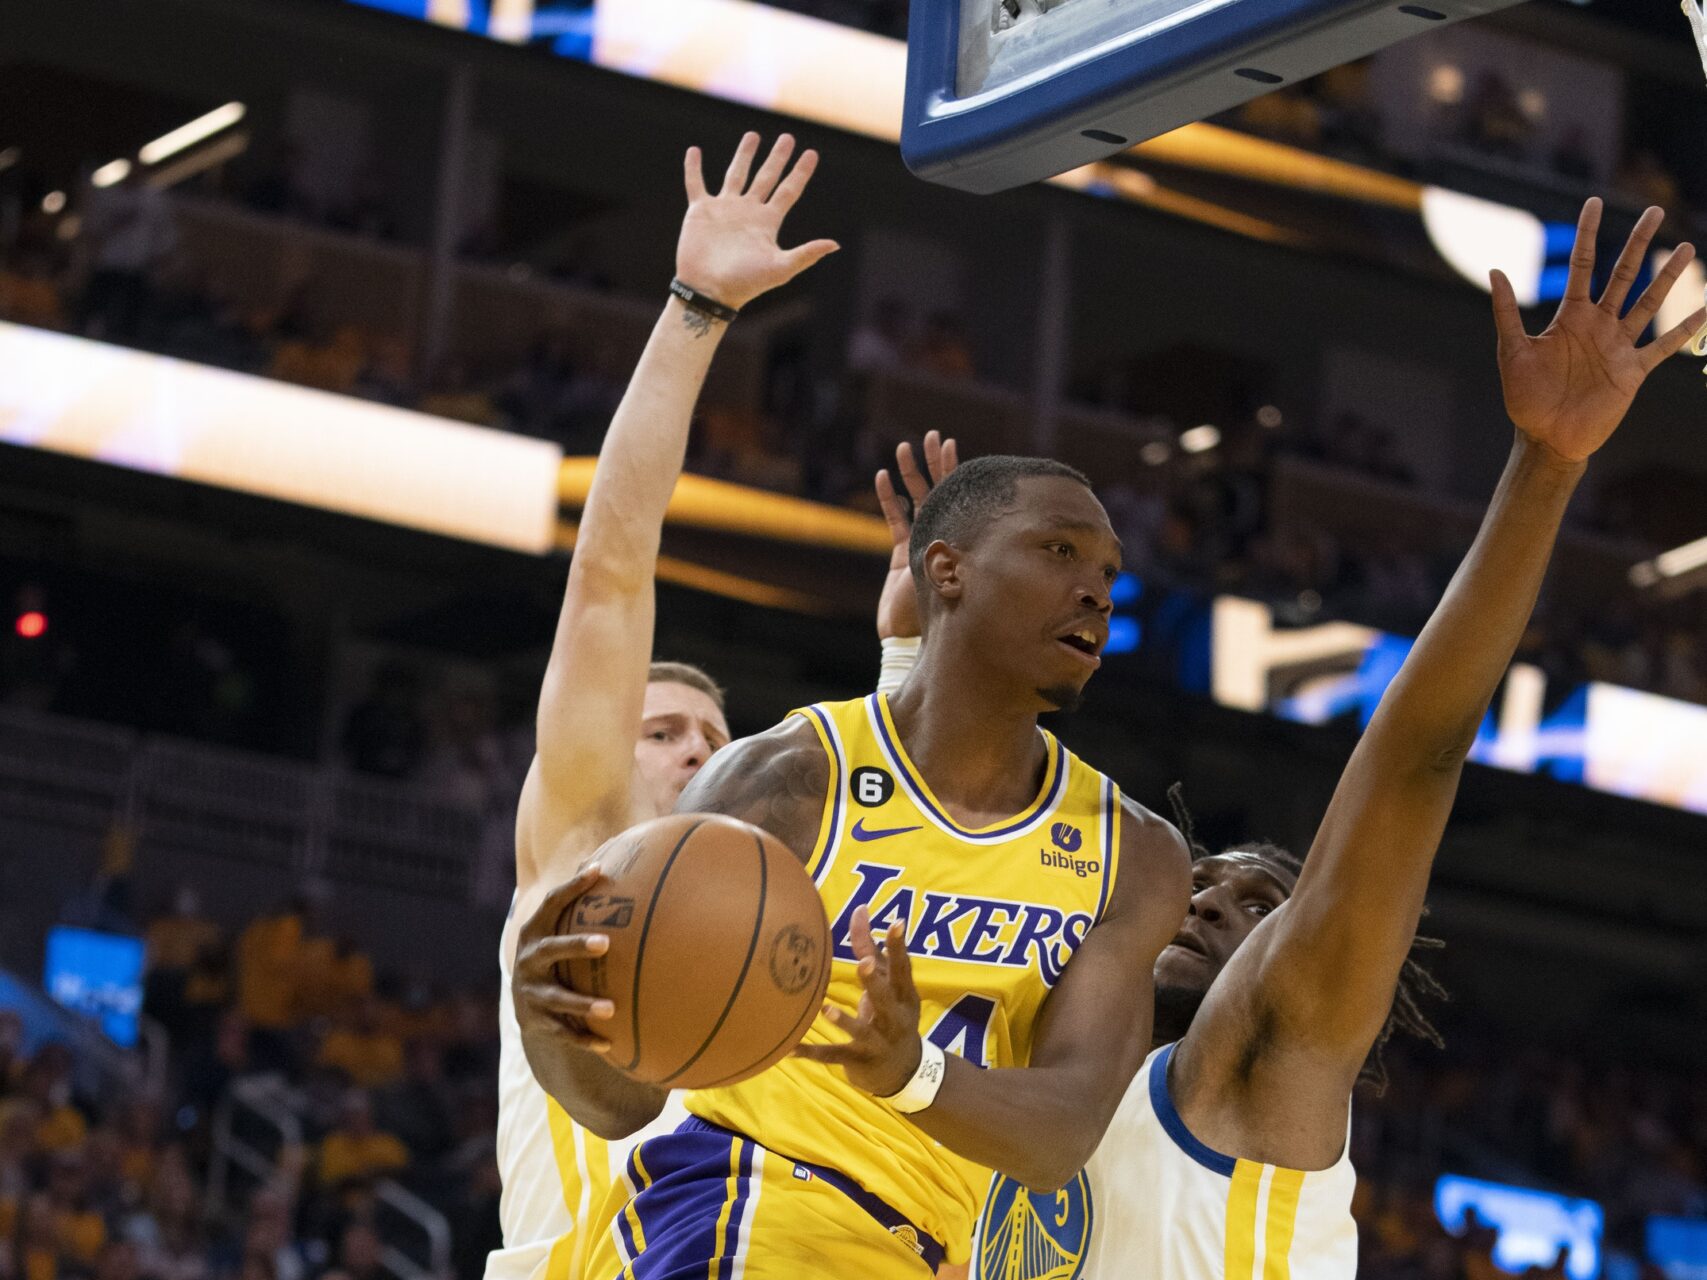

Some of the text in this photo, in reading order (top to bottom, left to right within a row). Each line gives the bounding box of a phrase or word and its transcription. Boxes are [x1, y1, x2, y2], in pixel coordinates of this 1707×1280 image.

[859, 772, 883, 803] 6
[1040, 848, 1100, 878] bibigo
[831, 861, 1097, 989] LAKERS
